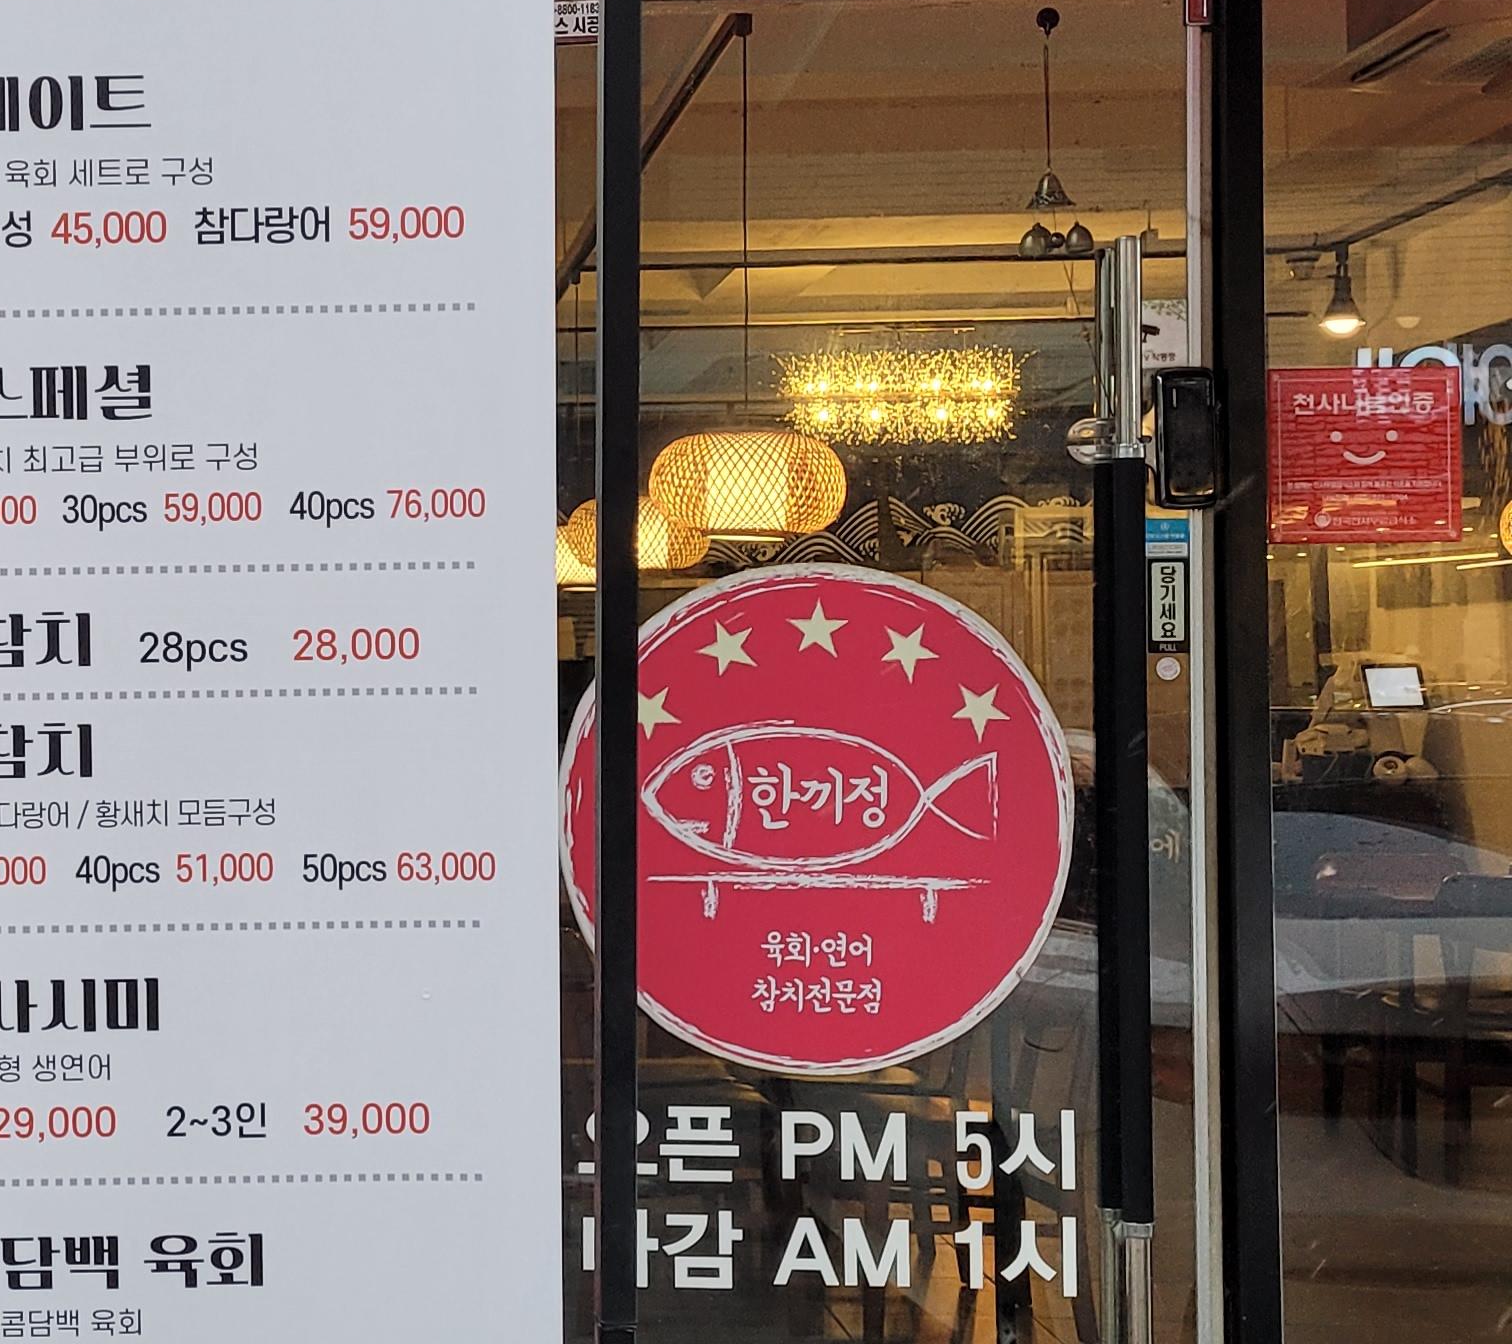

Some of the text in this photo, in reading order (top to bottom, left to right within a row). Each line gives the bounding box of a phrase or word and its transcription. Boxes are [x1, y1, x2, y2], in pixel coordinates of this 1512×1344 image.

[5, 159, 56, 188] 육회
[69, 159, 149, 186] 세트로
[162, 157, 212, 186] 구성
[51, 211, 166, 248] 45,000
[195, 206, 329, 244] 참다랑어
[349, 206, 465, 243] 59,000
[24, 445, 103, 473] 최고급
[115, 444, 195, 472] 부위로
[206, 443, 257, 471] 구성
[63, 495, 147, 531] 30pcs
[164, 492, 261, 526] 59,000
[290, 491, 374, 528] 40pcs
[387, 488, 485, 522] 76,000
[1160, 566, 1176, 638] 당기세요
[140, 632, 247, 671] 28pcs
[293, 628, 419, 665] 28,000
[1159, 642, 1177, 652] PULL
[96, 800, 168, 828] 황새치
[178, 798, 275, 826] 모듬구성
[747, 762, 889, 830] 한끼정
[76, 855, 160, 892] 40pcs
[176, 852, 273, 886] 51,000
[303, 854, 386, 890] 50pcs
[398, 852, 495, 885] 63,000
[752, 976, 882, 1014] 참치전문점
[33, 1054, 110, 1082] 생연어
[167, 1103, 266, 1138] 2~3인
[304, 1103, 429, 1139] 39,000
[782, 1111, 906, 1181] PM
[954, 1109, 1076, 1192] 5시
[0, 1236, 119, 1290] 담백
[144, 1232, 263, 1288] 육회
[774, 1217, 910, 1288] AM
[954, 1215, 1077, 1298] 1시
[91, 1308, 141, 1336] 육회
